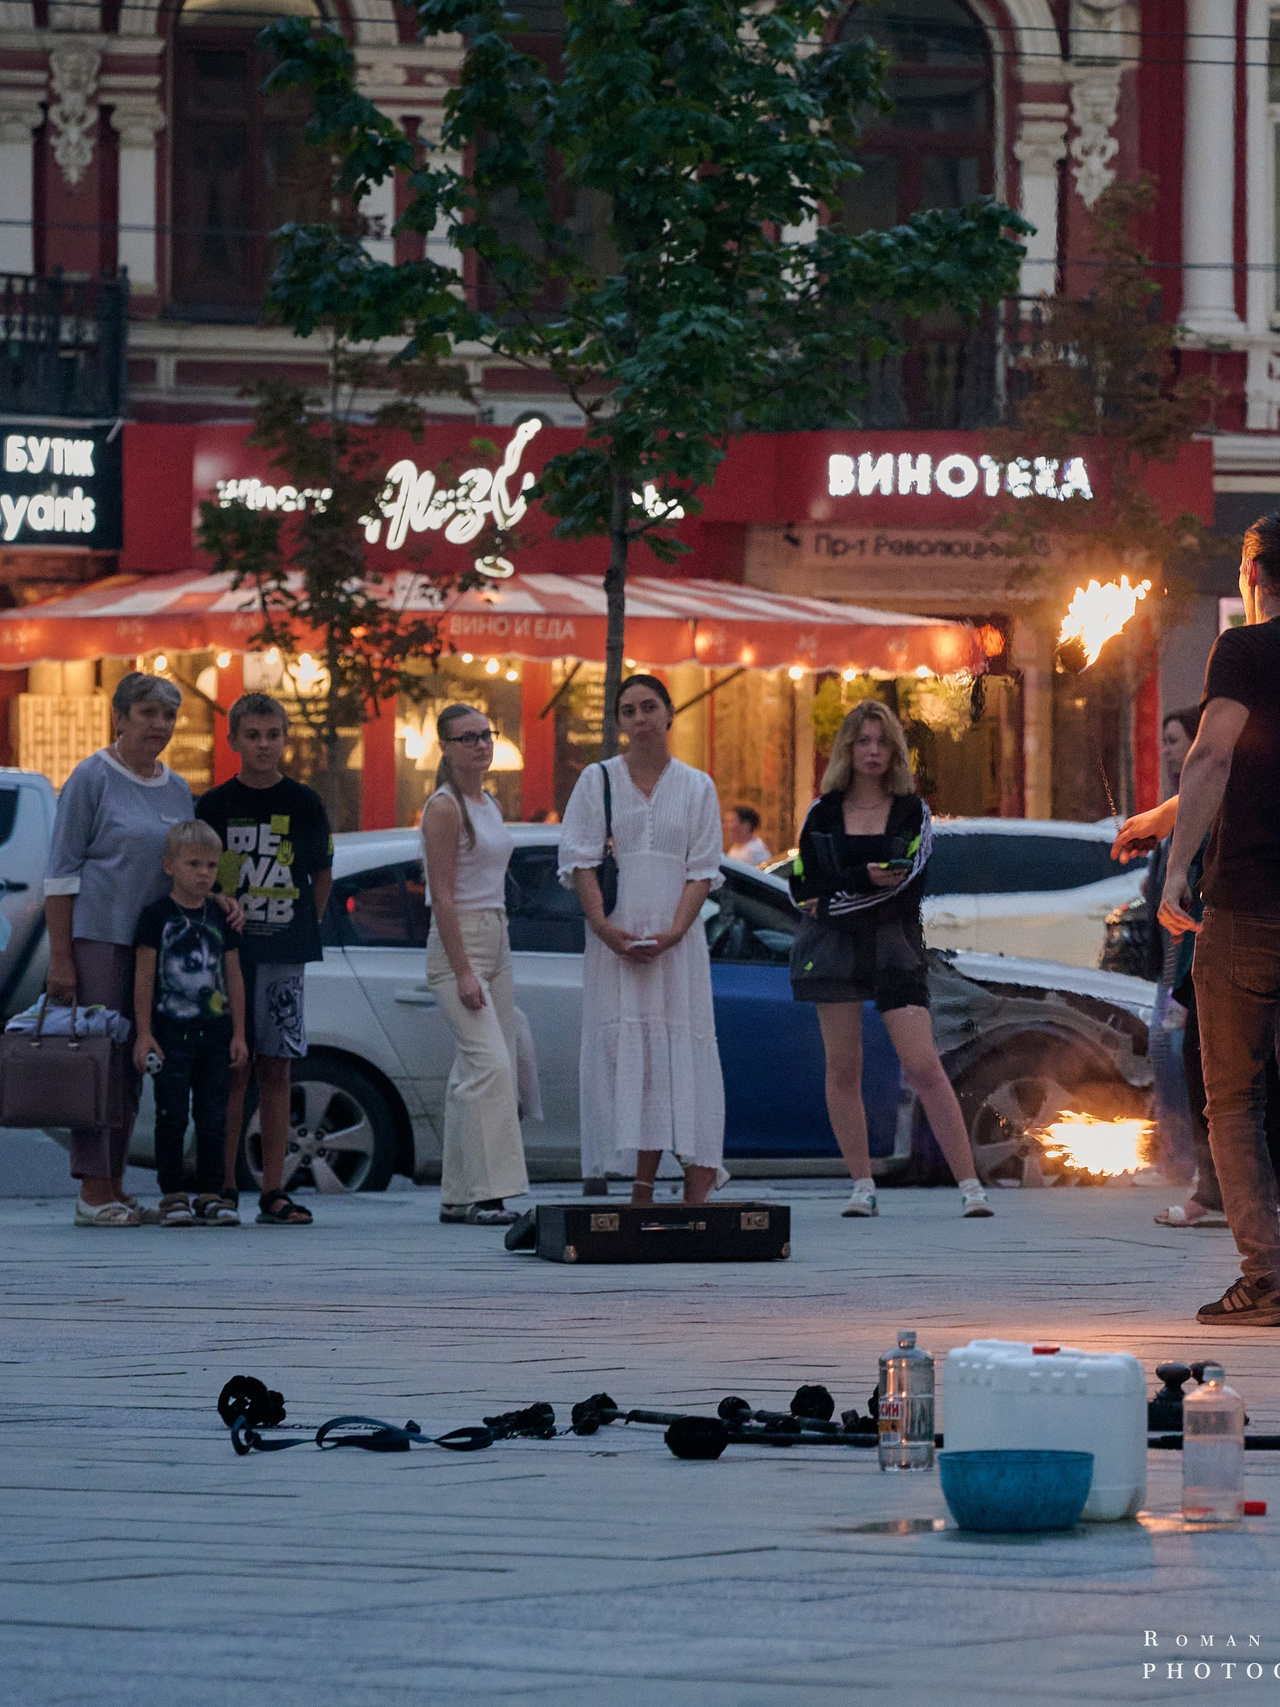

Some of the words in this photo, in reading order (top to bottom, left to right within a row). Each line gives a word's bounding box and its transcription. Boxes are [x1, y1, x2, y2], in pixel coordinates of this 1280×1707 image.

[828, 452, 1094, 502] ВИНОТЕКА
[450, 614, 511, 637] ВИНО
[514, 617, 531, 637] И
[534, 618, 577, 641] ЕДА
